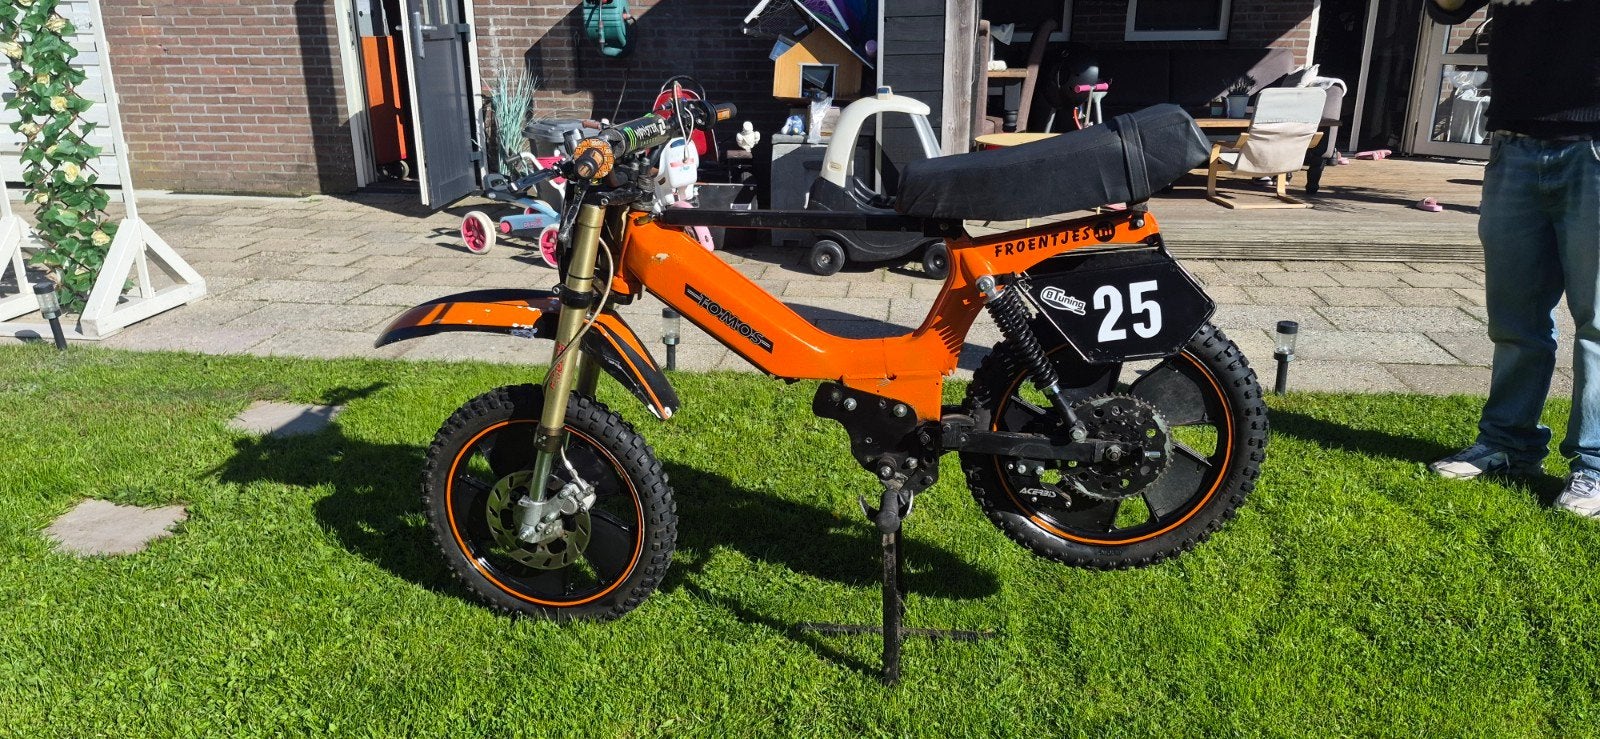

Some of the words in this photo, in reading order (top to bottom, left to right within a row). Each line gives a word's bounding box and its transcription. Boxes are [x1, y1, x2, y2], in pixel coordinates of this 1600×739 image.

[994, 226, 1090, 257] FROENTJES
[699, 292, 764, 345] TOMOS
[1092, 280, 1162, 342] 25
